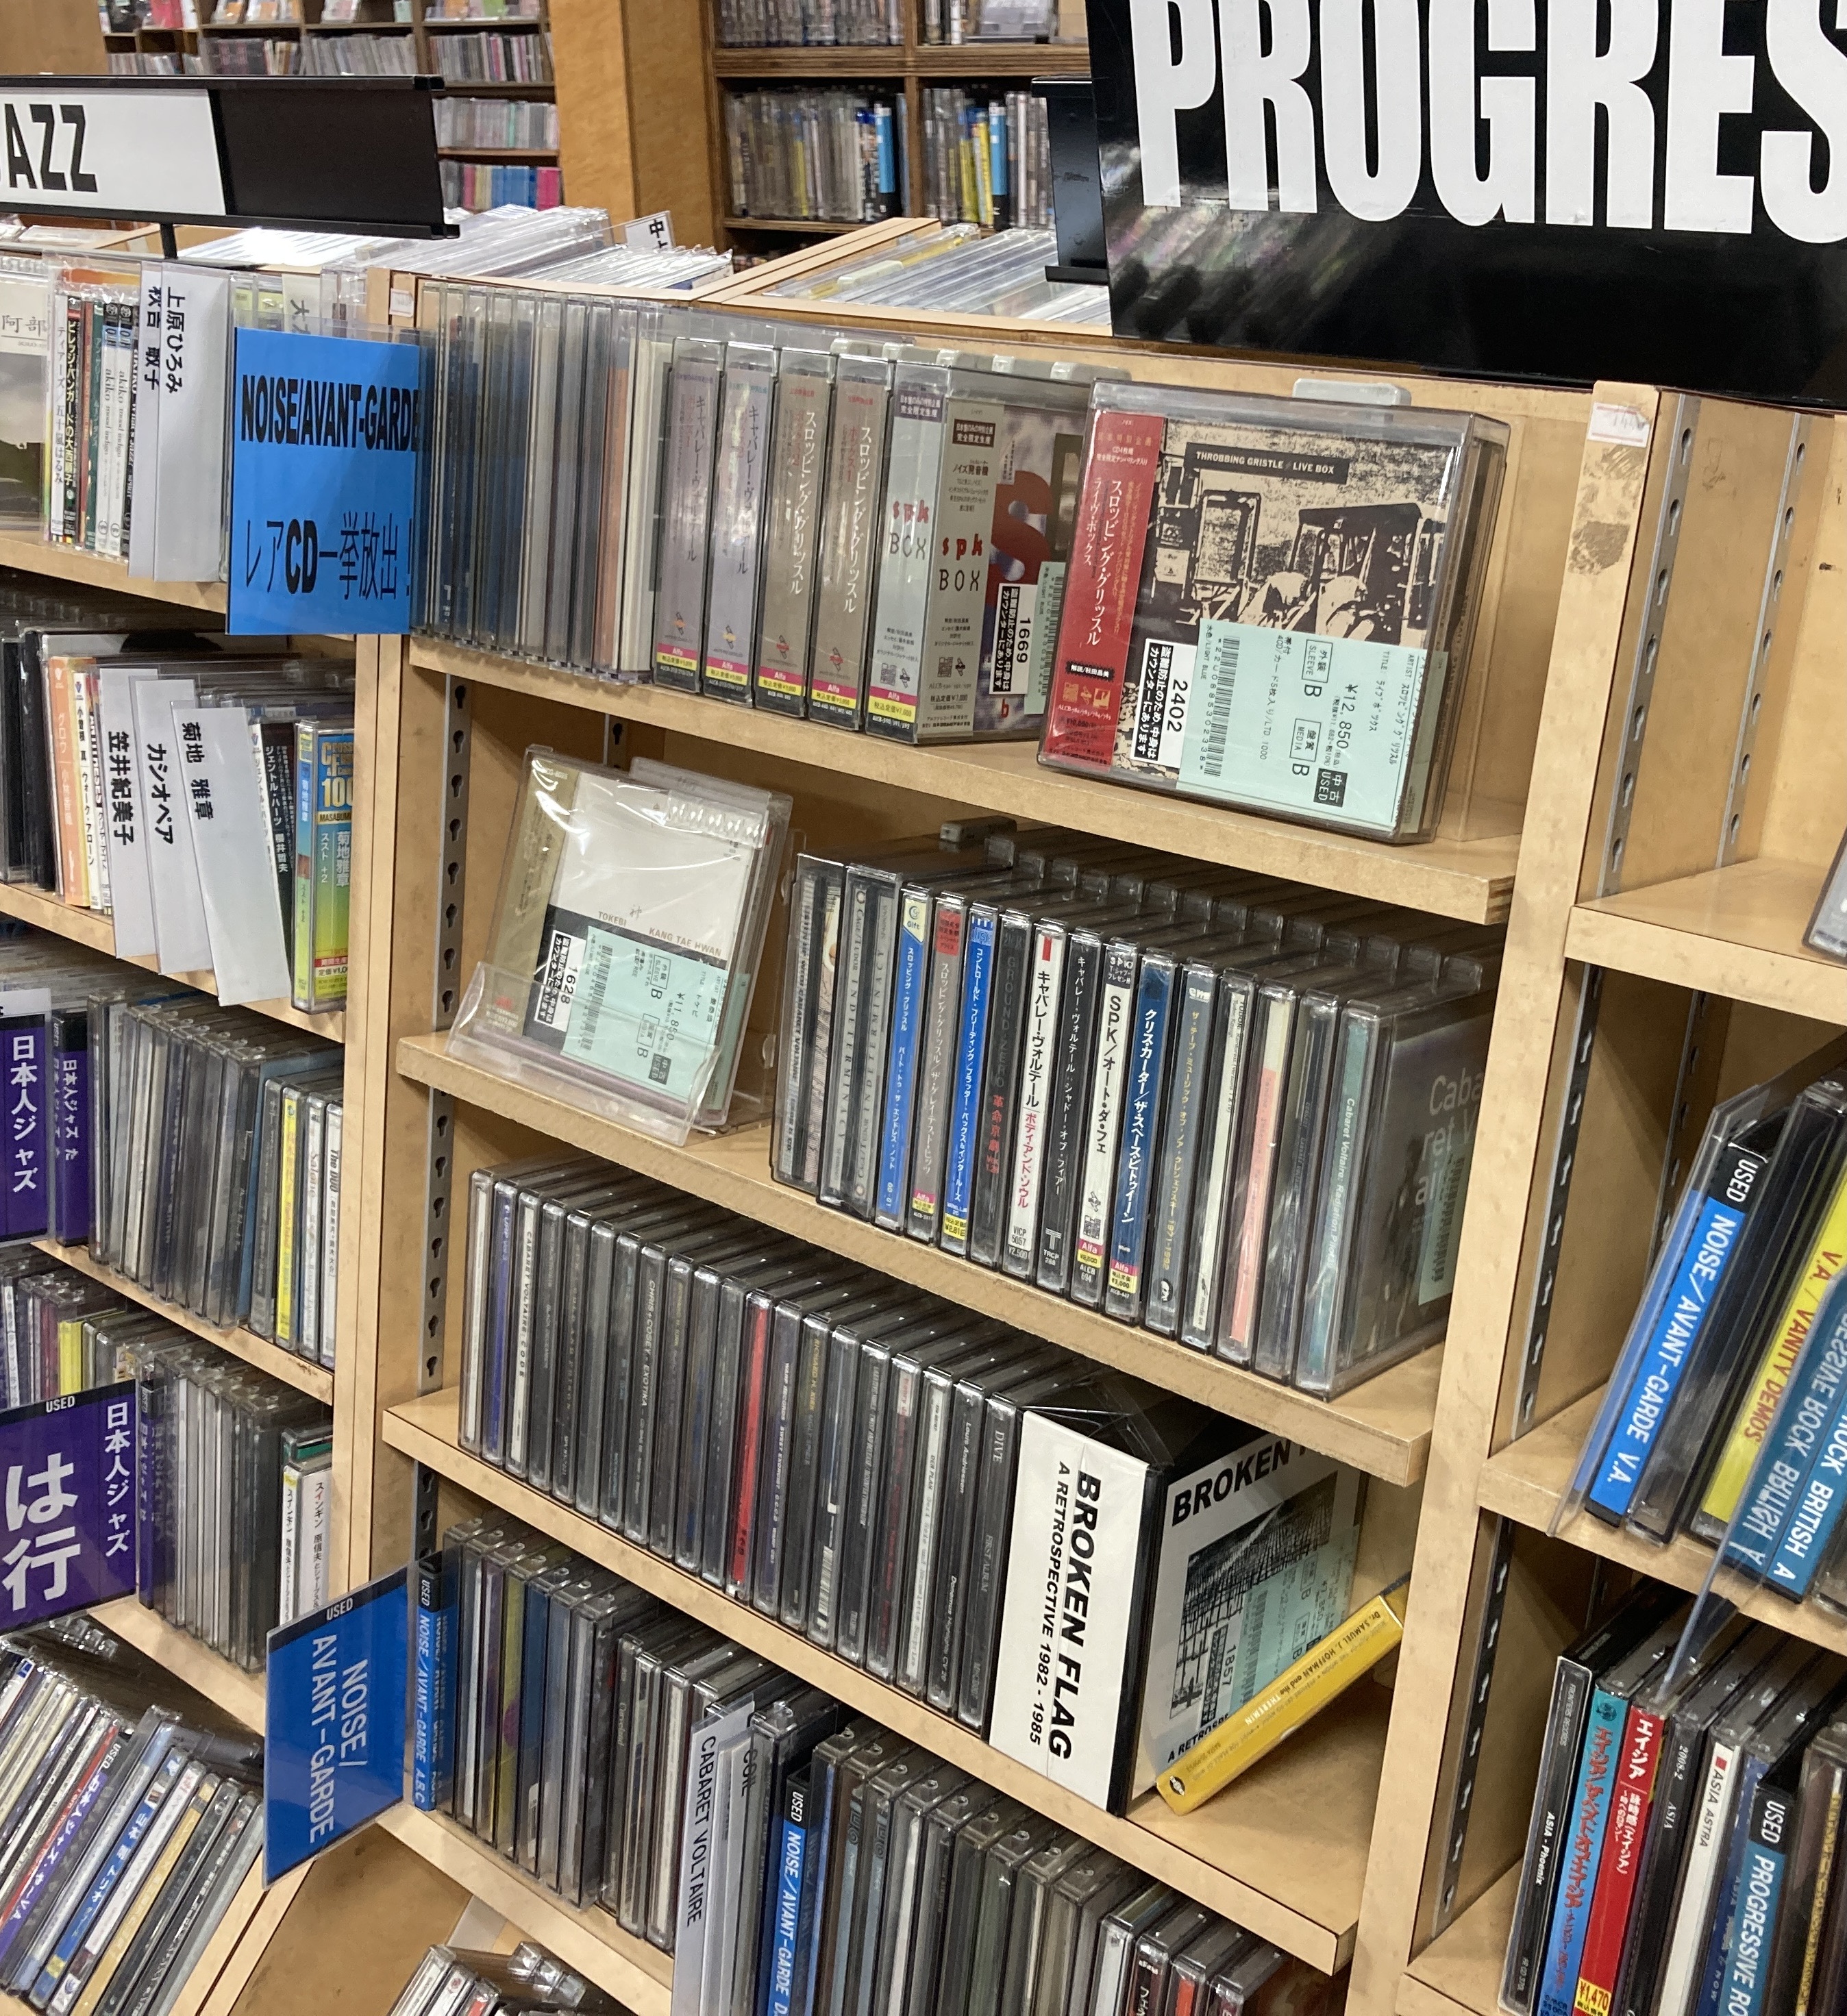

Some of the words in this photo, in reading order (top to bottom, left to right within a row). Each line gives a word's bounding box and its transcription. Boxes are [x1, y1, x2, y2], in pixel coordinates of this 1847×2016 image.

[1132, 0, 1847, 243] PROGRES
[0, 103, 98, 192] AZZ
[165, 286, 186, 394] 上原ひろみ
[104, 368, 116, 402] akiko
[118, 370, 128, 404] akiko
[241, 375, 420, 452] NOISE/AVANT-GARDE
[1195, 451, 1245, 465] THROBBING
[1247, 457, 1284, 469] GRISTLE
[1293, 462, 1313, 473] LIVE
[1315, 464, 1335, 475] BOX
[892, 499, 930, 524] spk
[889, 532, 927, 560] BOX
[942, 533, 983, 561] spk
[1086, 480, 1123, 646] スロッビング・グリッスル
[939, 569, 980, 593] BOX
[672, 647, 684, 656] Alfa
[994, 590, 1010, 689] カウンターにあります
[1016, 617, 1032, 664] 1669
[721, 661, 734, 671] Alfa
[774, 671, 786, 682] Alfa
[1200, 664, 1208, 680] BLUE
[1305, 645, 1317, 676] SLEEVE
[827, 684, 841, 694] Alfa
[887, 691, 900, 701] Alfa
[1137, 647, 1161, 755] カウンターにあります
[1304, 684, 1322, 697] B
[1166, 680, 1189, 733] 2402
[1336, 684, 1359, 749] ¥12,850
[182, 721, 204, 763] 菊地
[1294, 726, 1305, 751] MEDIA
[265, 745, 282, 827] ジェントル・ハーツ
[1291, 763, 1310, 776] B
[1317, 771, 1332, 801] USED
[108, 730, 135, 847] 笠井紀美子
[147, 743, 175, 845] カシオペア
[190, 778, 215, 821] 雅章
[1329, 774, 1343, 803] 中古
[321, 832, 330, 862] ススト
[321, 867, 329, 883] +2
[597, 910, 628, 926] TOKEBI
[649, 926, 673, 943] KANG
[676, 935, 692, 949] TAE
[694, 942, 722, 957] HWAN
[560, 966, 579, 1005] 1628
[797, 959, 808, 988] WITH
[650, 988, 663, 999] B
[795, 988, 806, 1034] CABARET
[1065, 956, 1087, 1073] キャバレー・ヴォルテール
[636, 1047, 649, 1059] B
[1025, 969, 1052, 1108] キャバレー・ヴォルテール
[650, 1054, 662, 1080] USED
[791, 1036, 802, 1082] VOLTAIRE
[837, 978, 859, 1141] INDETERMINACY
[1095, 994, 1123, 1155] SPK/オート・ダ・フェ
[10, 1035, 38, 1193] 日本人ジャズ
[62, 1059, 80, 1138] 日本人ジャズ
[1341, 1097, 1356, 1138] Cabaret
[64, 1147, 79, 1161] た
[330, 1149, 339, 1169] The
[1726, 1159, 1759, 1204] USED
[1011, 1234, 1026, 1245] 5057
[1013, 1225, 1027, 1236] VICP
[1080, 1240, 1098, 1253] Alfa
[524, 1231, 533, 1277] CABARET
[1078, 1263, 1096, 1275] ALCB
[1113, 1260, 1130, 1273] Alfa
[521, 1280, 531, 1338] VOLTAIRE
[1772, 1309, 1815, 1377] VANITY
[641, 1362, 651, 1408] EXOTIKA
[45, 1395, 75, 1413] USED
[1744, 1378, 1783, 1443] DEMOS
[992, 1430, 1006, 1464] DIVE
[104, 1402, 132, 1557] 日本人ジャズ
[1058, 1462, 1070, 1479] A
[1171, 1437, 1292, 1527] BROKEN
[1607, 1454, 1640, 1485] V.A.
[1, 1452, 81, 1611] は行
[1784, 1480, 1835, 1558] BRITISH
[982, 1534, 993, 1559] FIRST
[1041, 1481, 1069, 1639] RETROSPECTIVE
[1061, 1471, 1102, 1650] BROKEN
[1773, 1561, 1796, 1580] A
[326, 1597, 354, 1621] USED
[421, 1578, 431, 1607] USED
[1302, 1587, 1312, 1601] B
[1342, 1617, 1372, 1643] SAMUEL
[1037, 1643, 1052, 1687] 1982
[1222, 1643, 1237, 1686] 1857
[1292, 1647, 1302, 1660] B
[1302, 1647, 1337, 1675] HOFFMAN
[1289, 1674, 1303, 1687] and
[338, 1658, 369, 1767] NOISE/
[1049, 1655, 1082, 1760] FLAG
[309, 1634, 338, 1844] AVANT-GARDE
[1029, 1704, 1044, 1746] 1985
[102, 1743, 122, 1769] USED
[1167, 1750, 1176, 1763] A
[1628, 1719, 1654, 1780] エイジア
[695, 1735, 717, 1826] CABARET
[1707, 1770, 1724, 1804] ASIA
[790, 1791, 804, 1822] USED
[1544, 1810, 1557, 1837] ASIA
[1760, 1800, 1787, 1844] USED
[1698, 1808, 1714, 1847] ASTRA
[686, 1827, 709, 1928] VOLTAIRE
[1535, 1843, 1550, 1886] Phoenix
[1732, 1854, 1776, 1989] PROGRESSIVE
[1579, 1984, 1610, 2011] ¥1,470
